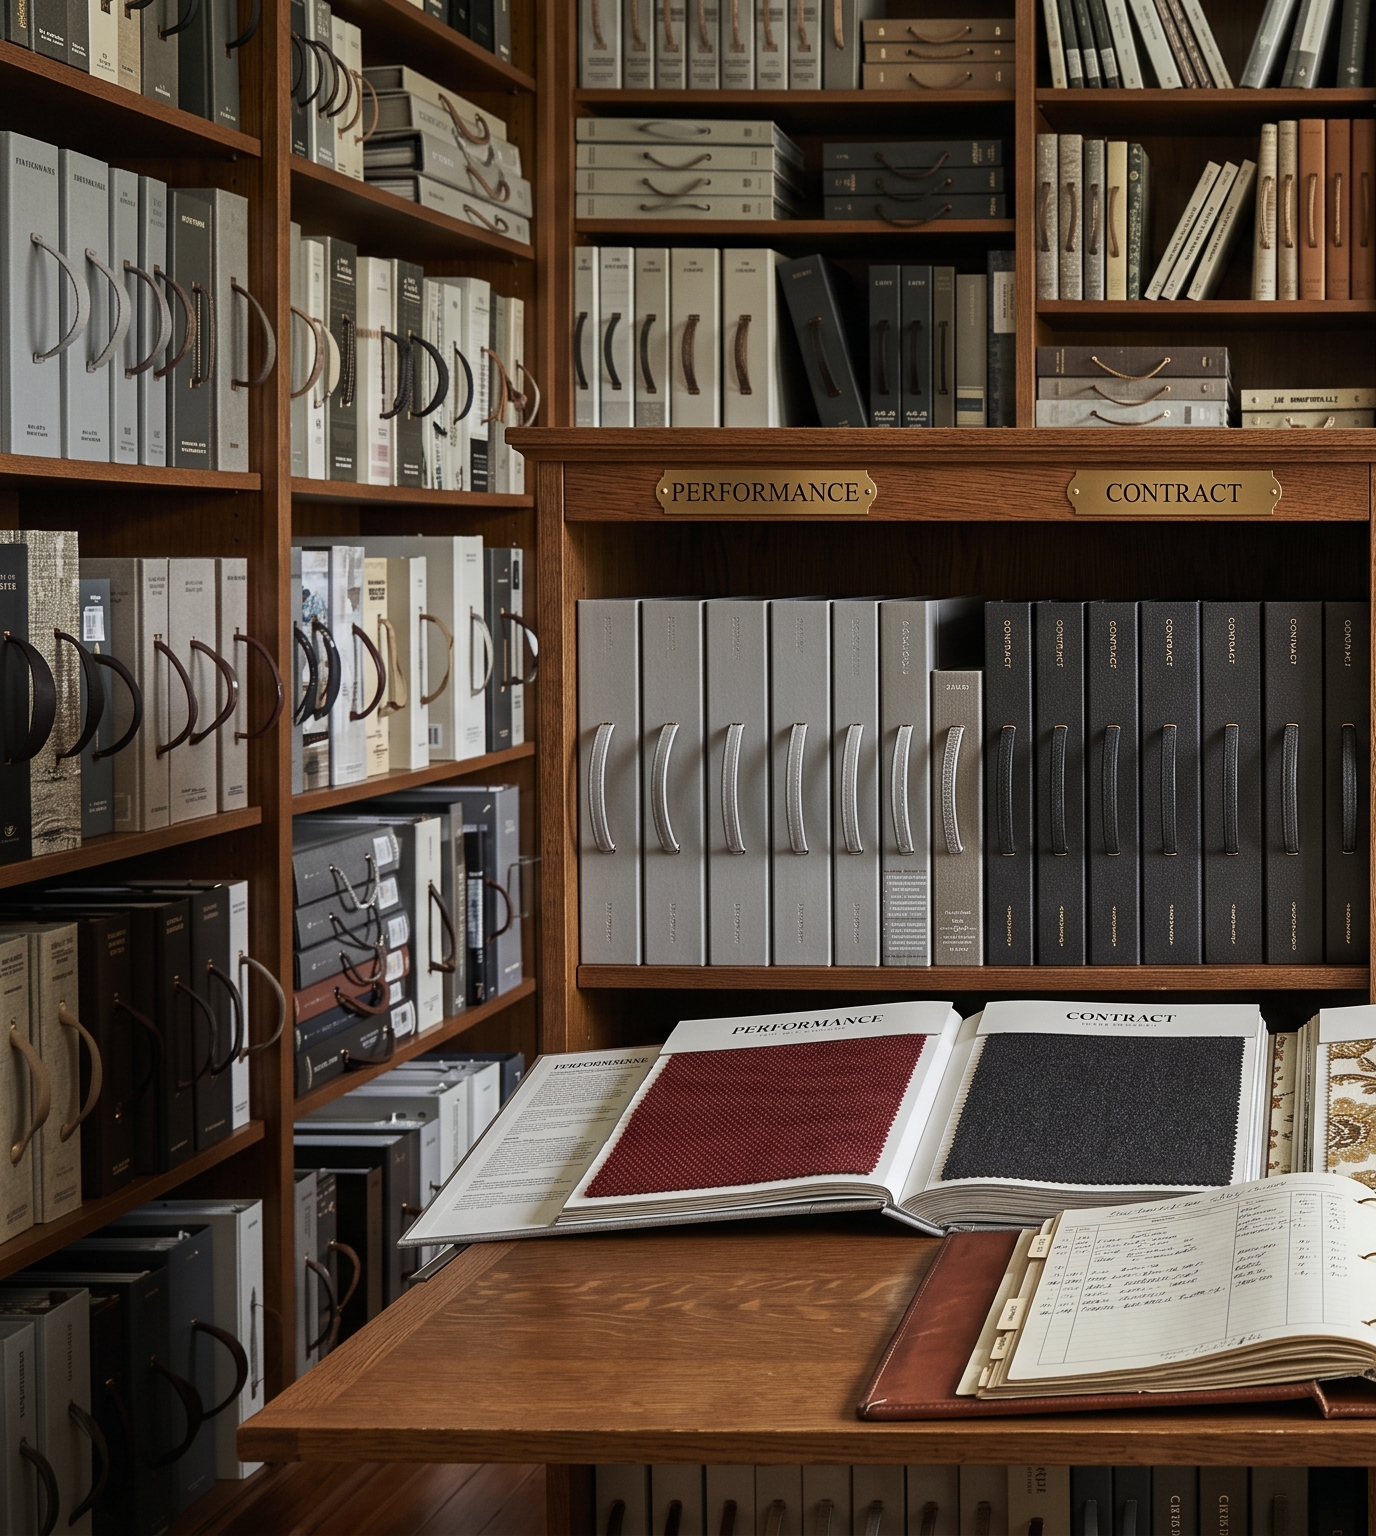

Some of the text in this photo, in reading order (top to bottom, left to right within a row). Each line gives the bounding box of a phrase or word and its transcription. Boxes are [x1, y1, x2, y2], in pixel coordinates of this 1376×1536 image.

[671, 482, 860, 503] PERFORMANCE
[1106, 483, 1243, 503] CONTRACT
[732, 1014, 884, 1035] PERFORMANCE
[1066, 1012, 1177, 1023] CONTRACT
